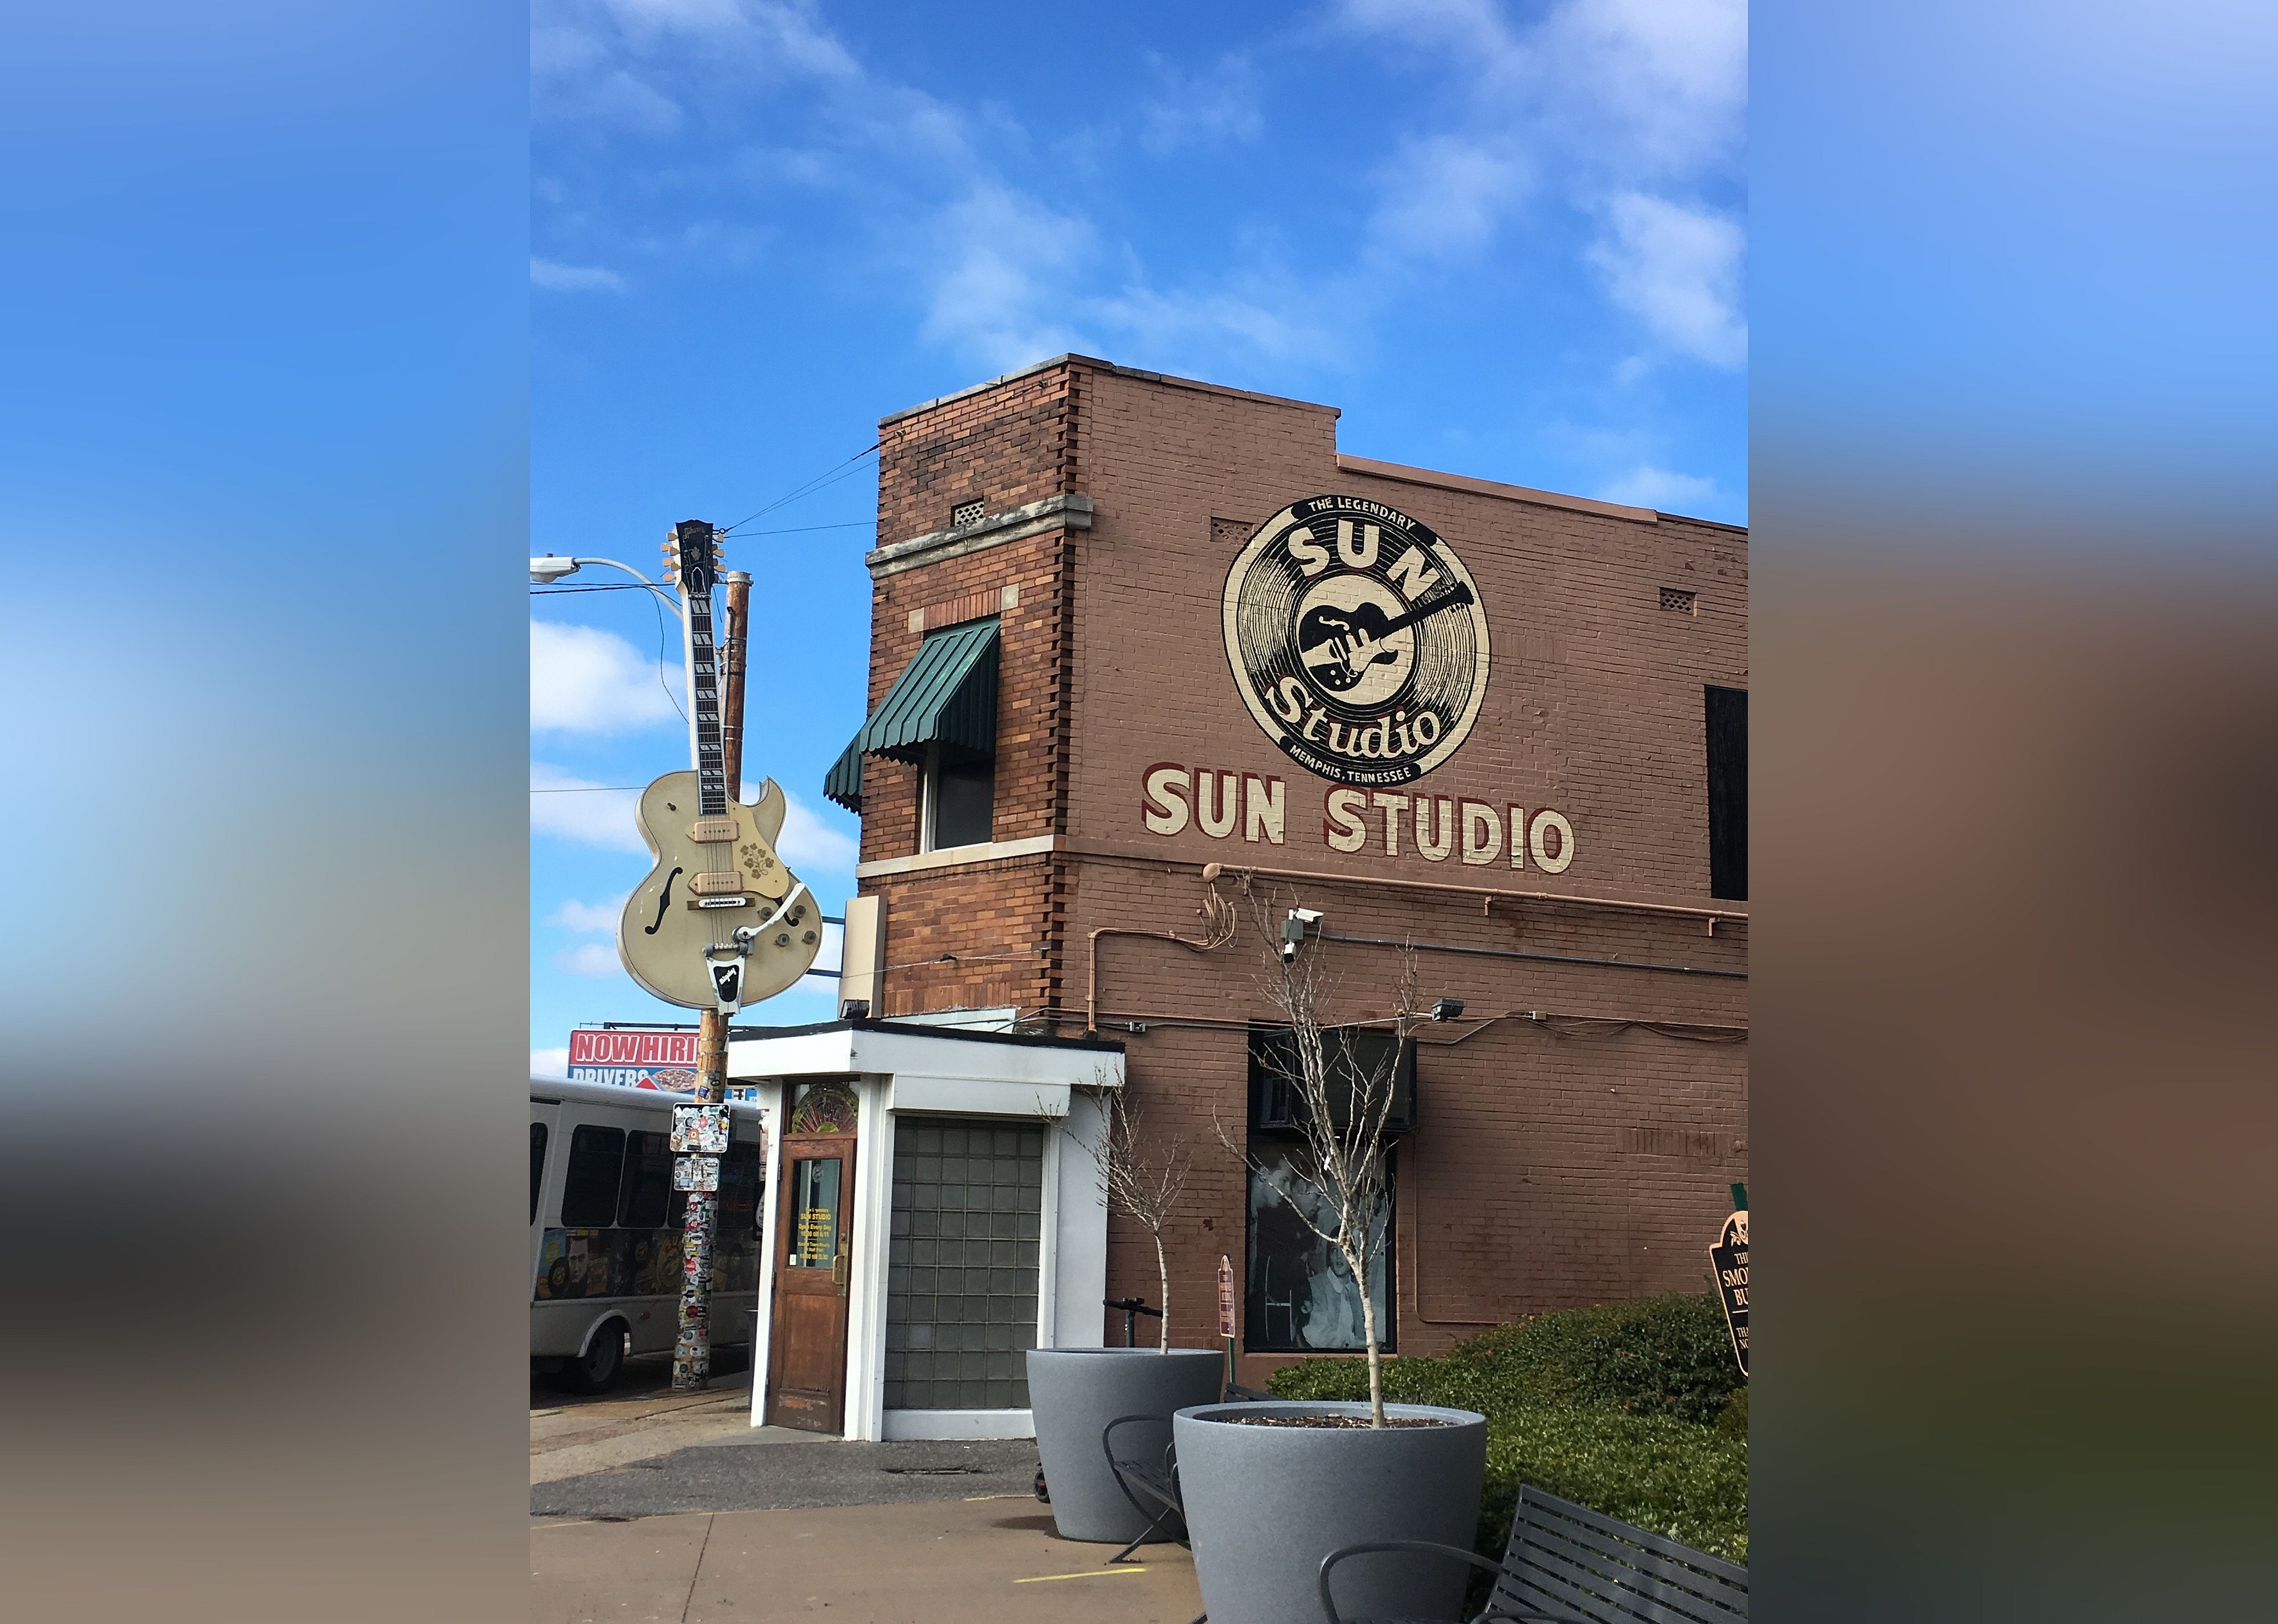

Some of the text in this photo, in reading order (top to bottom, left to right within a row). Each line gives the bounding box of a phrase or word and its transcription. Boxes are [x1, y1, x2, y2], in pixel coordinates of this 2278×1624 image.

[1308, 497, 1416, 530] THE LEGENDARY
[1287, 519, 1441, 602] SUN
[1264, 674, 1441, 758] Studio
[1290, 745, 1411, 783] MEMPHIS, TENNESSEE
[1142, 762, 1575, 874] SUN STUDIO
[576, 1034, 700, 1064] NOW HIRI
[1734, 1252, 1748, 1265] THI
[1723, 1267, 1748, 1287] SMO
